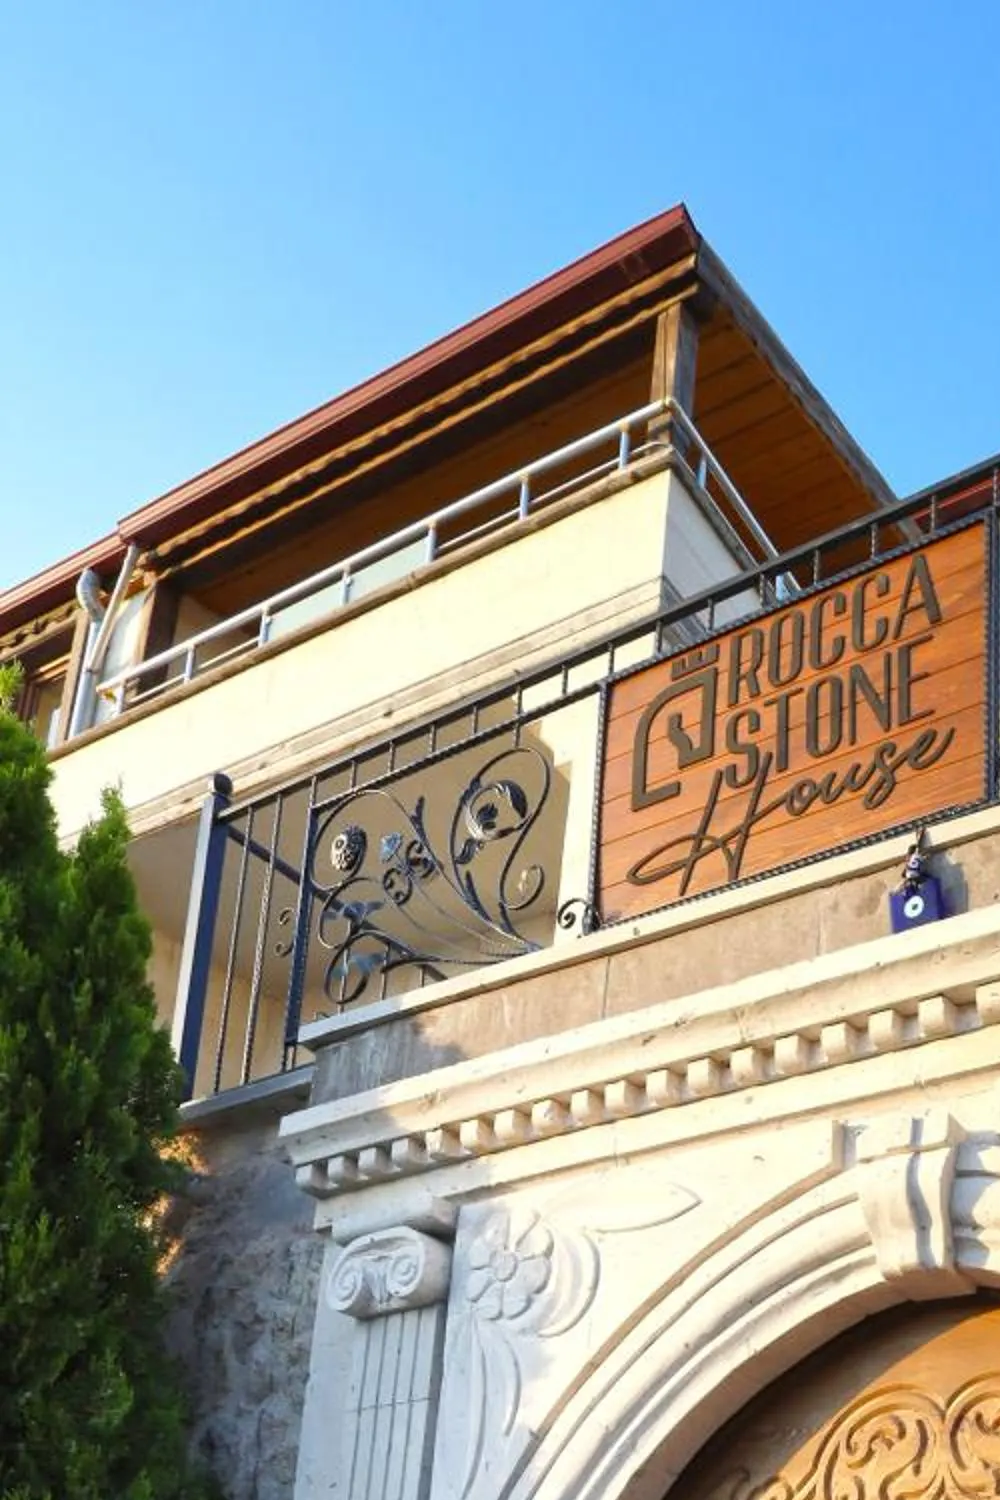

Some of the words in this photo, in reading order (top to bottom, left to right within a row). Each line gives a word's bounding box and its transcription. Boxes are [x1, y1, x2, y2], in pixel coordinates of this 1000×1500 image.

[727, 553, 943, 706] ROCCA
[725, 634, 935, 789] STONE
[626, 727, 957, 897] House
